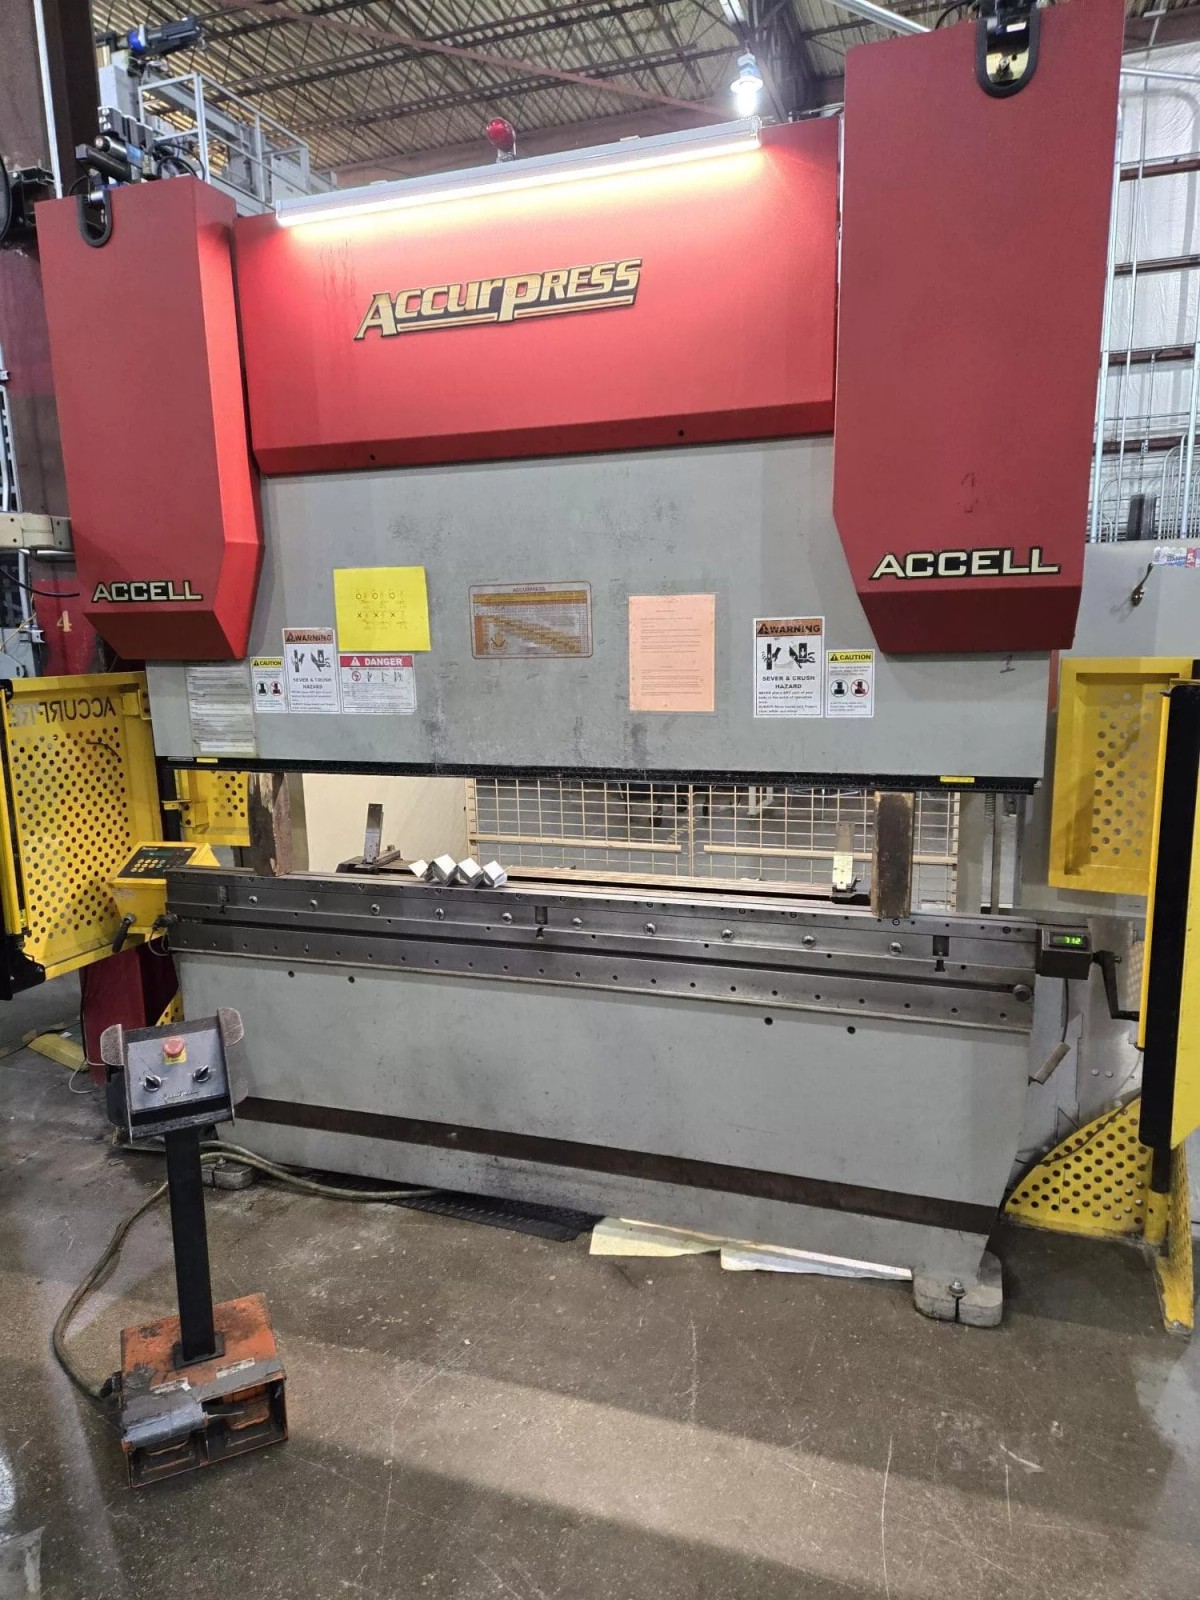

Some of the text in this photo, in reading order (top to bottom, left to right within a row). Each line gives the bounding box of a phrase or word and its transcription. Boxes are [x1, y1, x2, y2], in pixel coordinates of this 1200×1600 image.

[869, 547, 1061, 580] ACCELL
[92, 580, 202, 602] ACCELL
[56, 610, 73, 633] 4
[770, 624, 821, 634] WARNING
[295, 633, 333, 642] WARNING
[364, 657, 403, 666] DANGER
[839, 653, 872, 661] CAUTION
